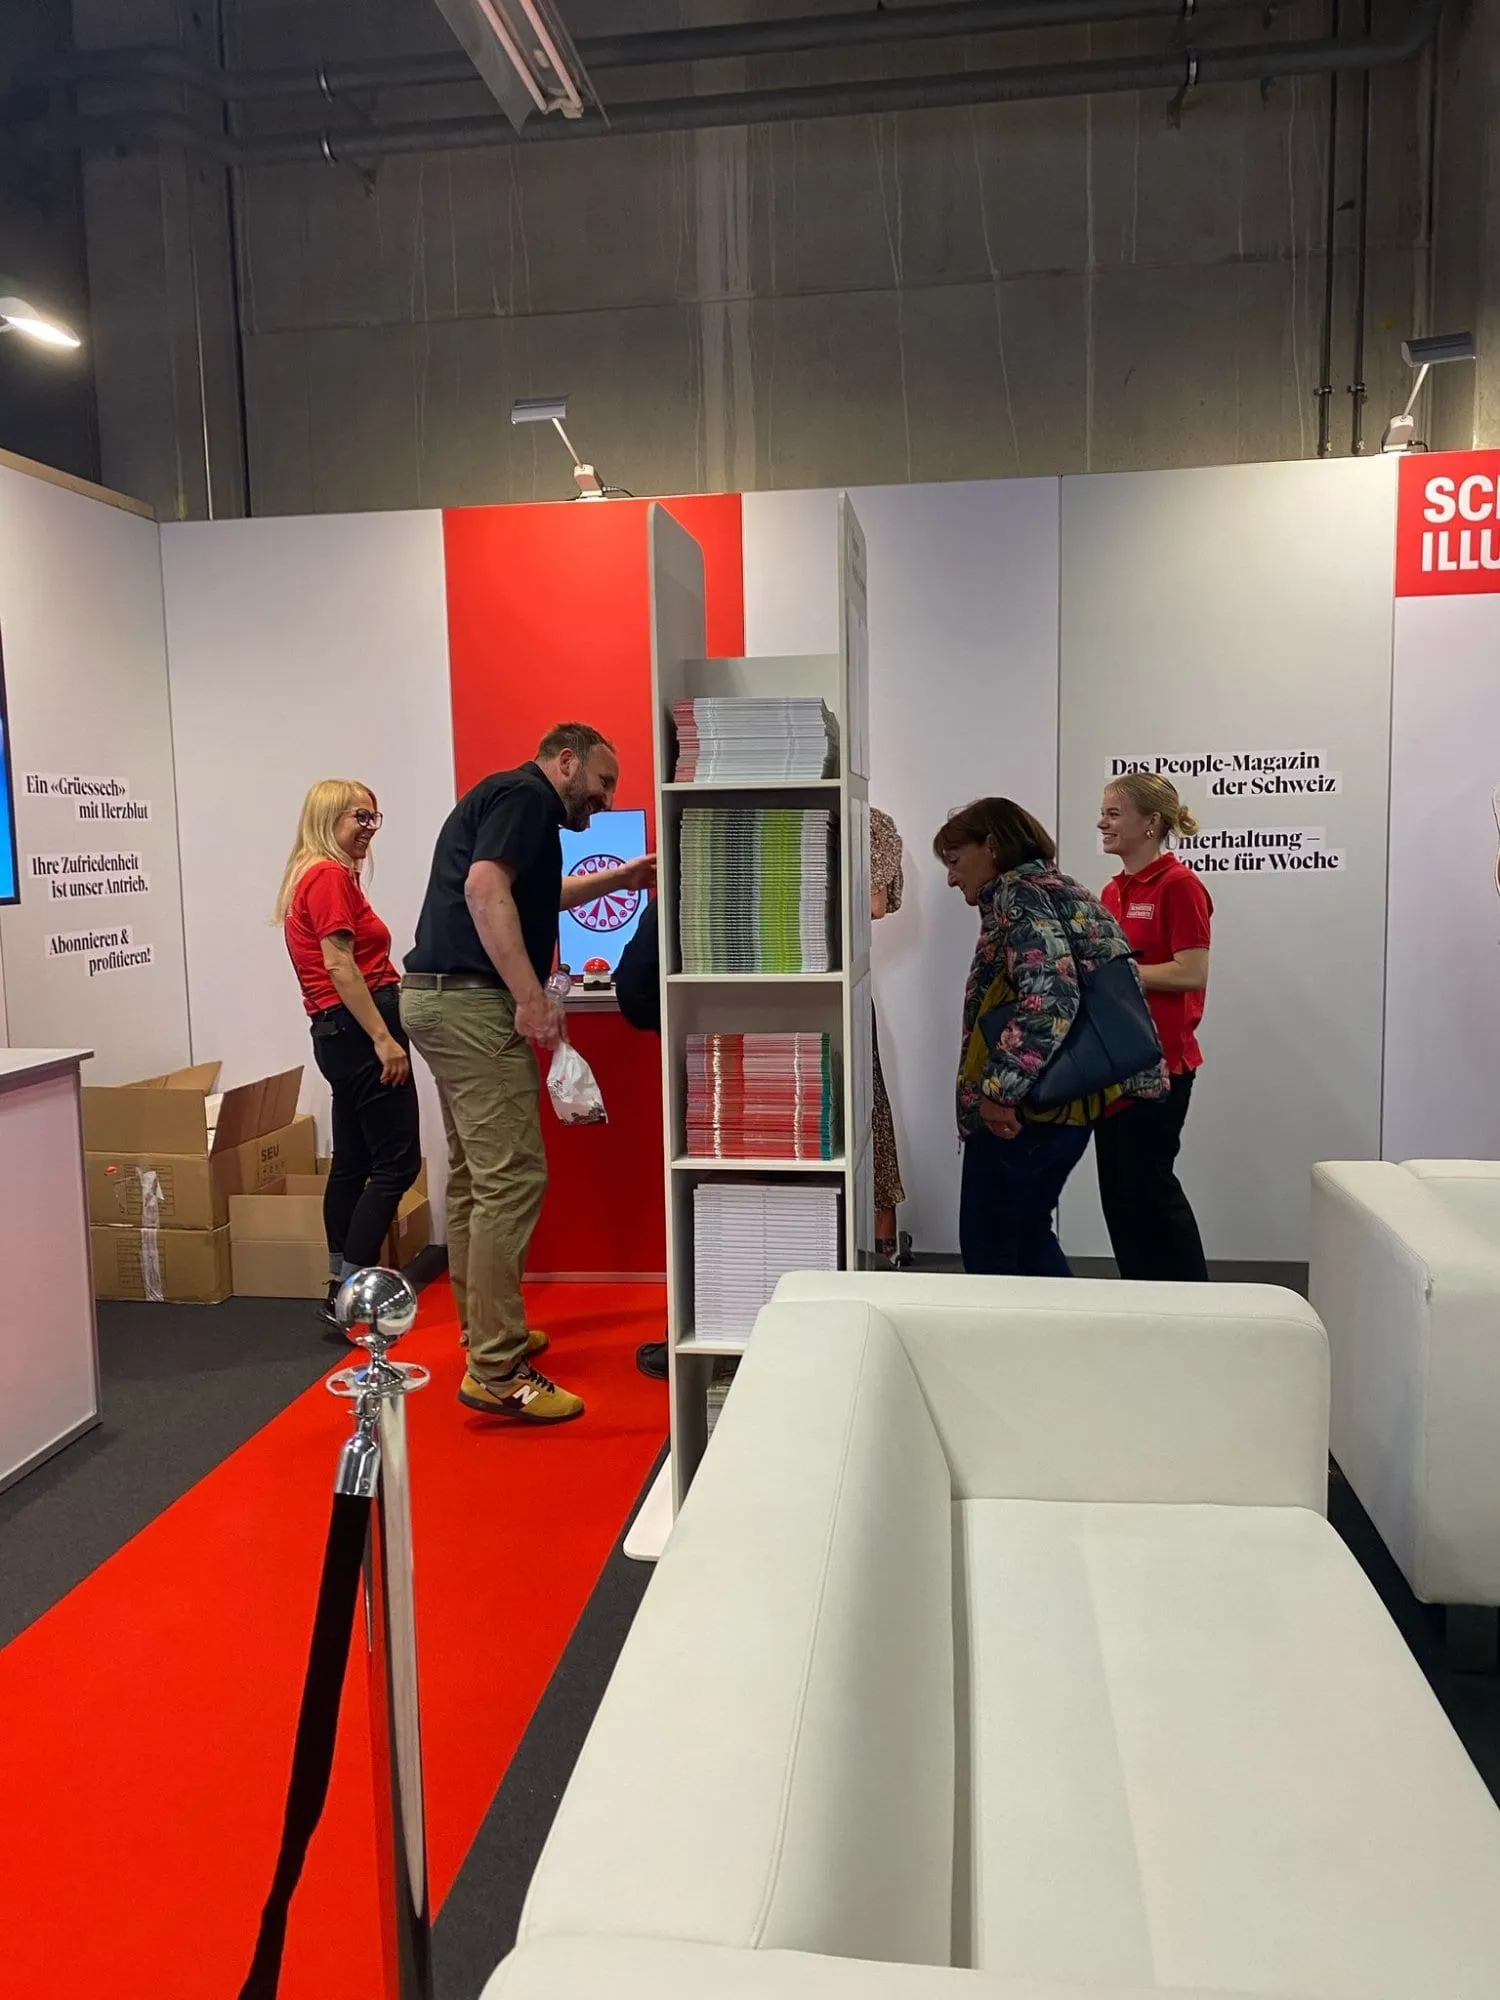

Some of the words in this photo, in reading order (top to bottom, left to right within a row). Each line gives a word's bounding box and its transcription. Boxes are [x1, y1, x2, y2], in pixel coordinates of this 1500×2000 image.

[1111, 758, 1150, 776] Das
[1155, 751, 1320, 777] People-Magazin
[26, 775, 49, 794] Ein
[50, 777, 126, 797] «Grüessech»
[1212, 777, 1247, 796] der
[1251, 774, 1336, 795] Schweiz
[79, 801, 99, 819] mit
[101, 802, 148, 820] Herzblut
[32, 856, 59, 875] Ihre
[61, 853, 139, 874] Zufriedenheit
[1179, 853, 1229, 872] oche
[1234, 852, 1266, 871] für
[1268, 851, 1339, 870] Woche
[52, 880, 67, 898] ist
[70, 881, 104, 897] unser
[104, 875, 149, 895] Antrieb.
[49, 932, 118, 955] Abonnieren
[120, 928, 129, 945] &
[89, 948, 151, 977] profitieren!
[512, 1385, 540, 1405] N
